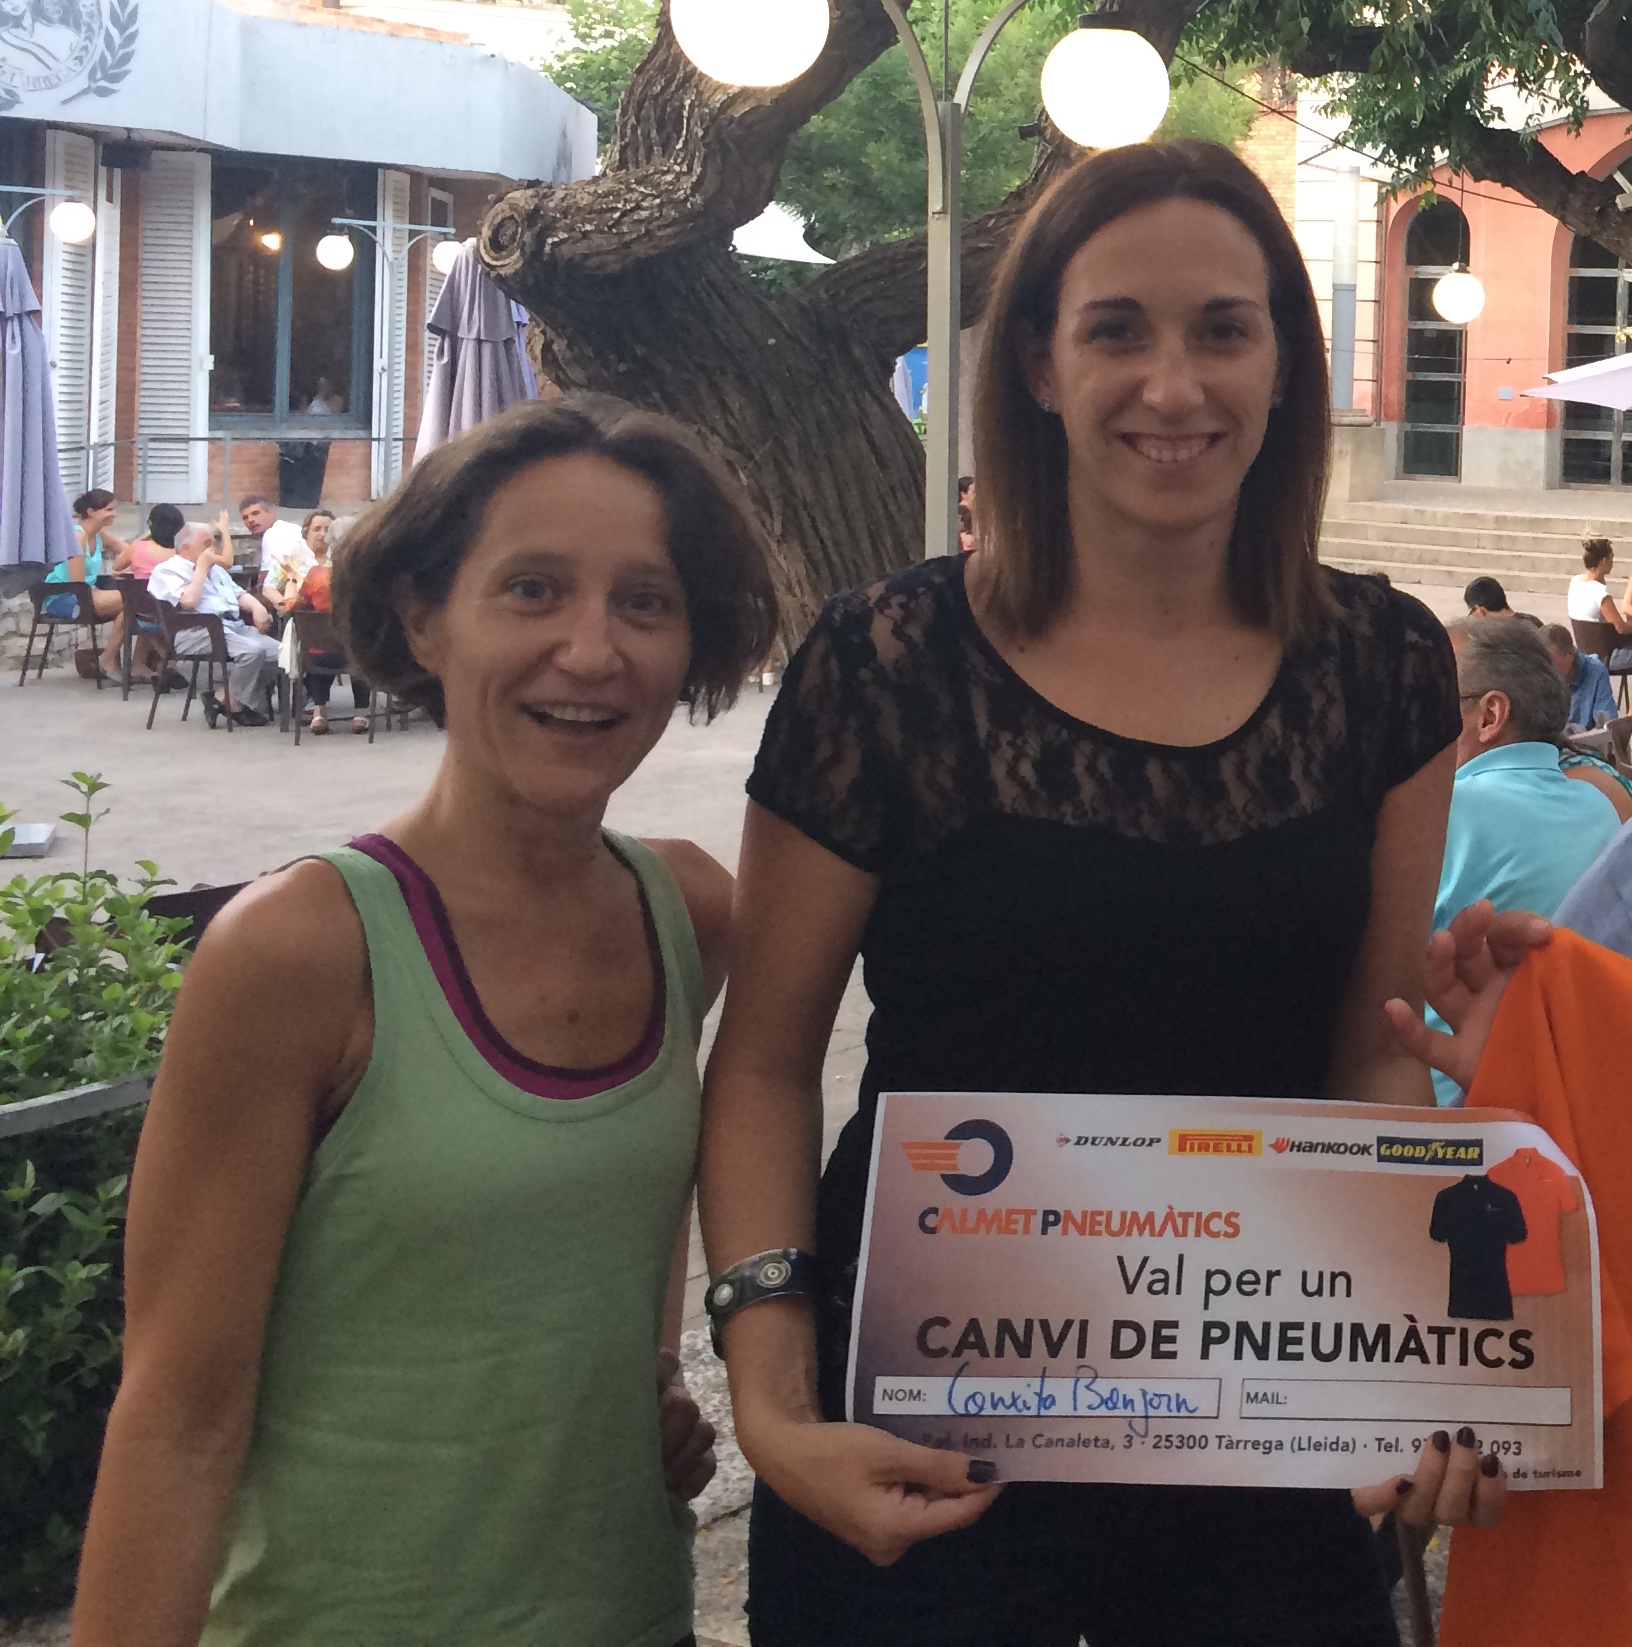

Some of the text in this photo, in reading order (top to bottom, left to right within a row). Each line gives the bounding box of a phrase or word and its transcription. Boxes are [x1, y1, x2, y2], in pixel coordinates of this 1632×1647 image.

[1073, 1134, 1162, 1148] DUNLOP
[1177, 1133, 1254, 1154] PIRELLI
[918, 1204, 1241, 1239] CALMET PNEUMÀTICS
[1116, 1253, 1353, 1311] Val per un
[916, 1314, 1536, 1370] CANVI DE PNEUMÀTICS
[882, 1388, 927, 1403] NOM:
[1245, 1391, 1288, 1406] MAIL:
[1005, 1433, 1025, 1449] La
[1032, 1433, 1116, 1452] Canaleta,
[1123, 1434, 1134, 1450] 3
[1152, 1434, 1209, 1451] 25300
[1215, 1434, 1285, 1455] Tàrrega
[1290, 1435, 1357, 1455] (Lleida)
[1375, 1437, 1404, 1454] Tel.
[1490, 1439, 1523, 1457] 093
